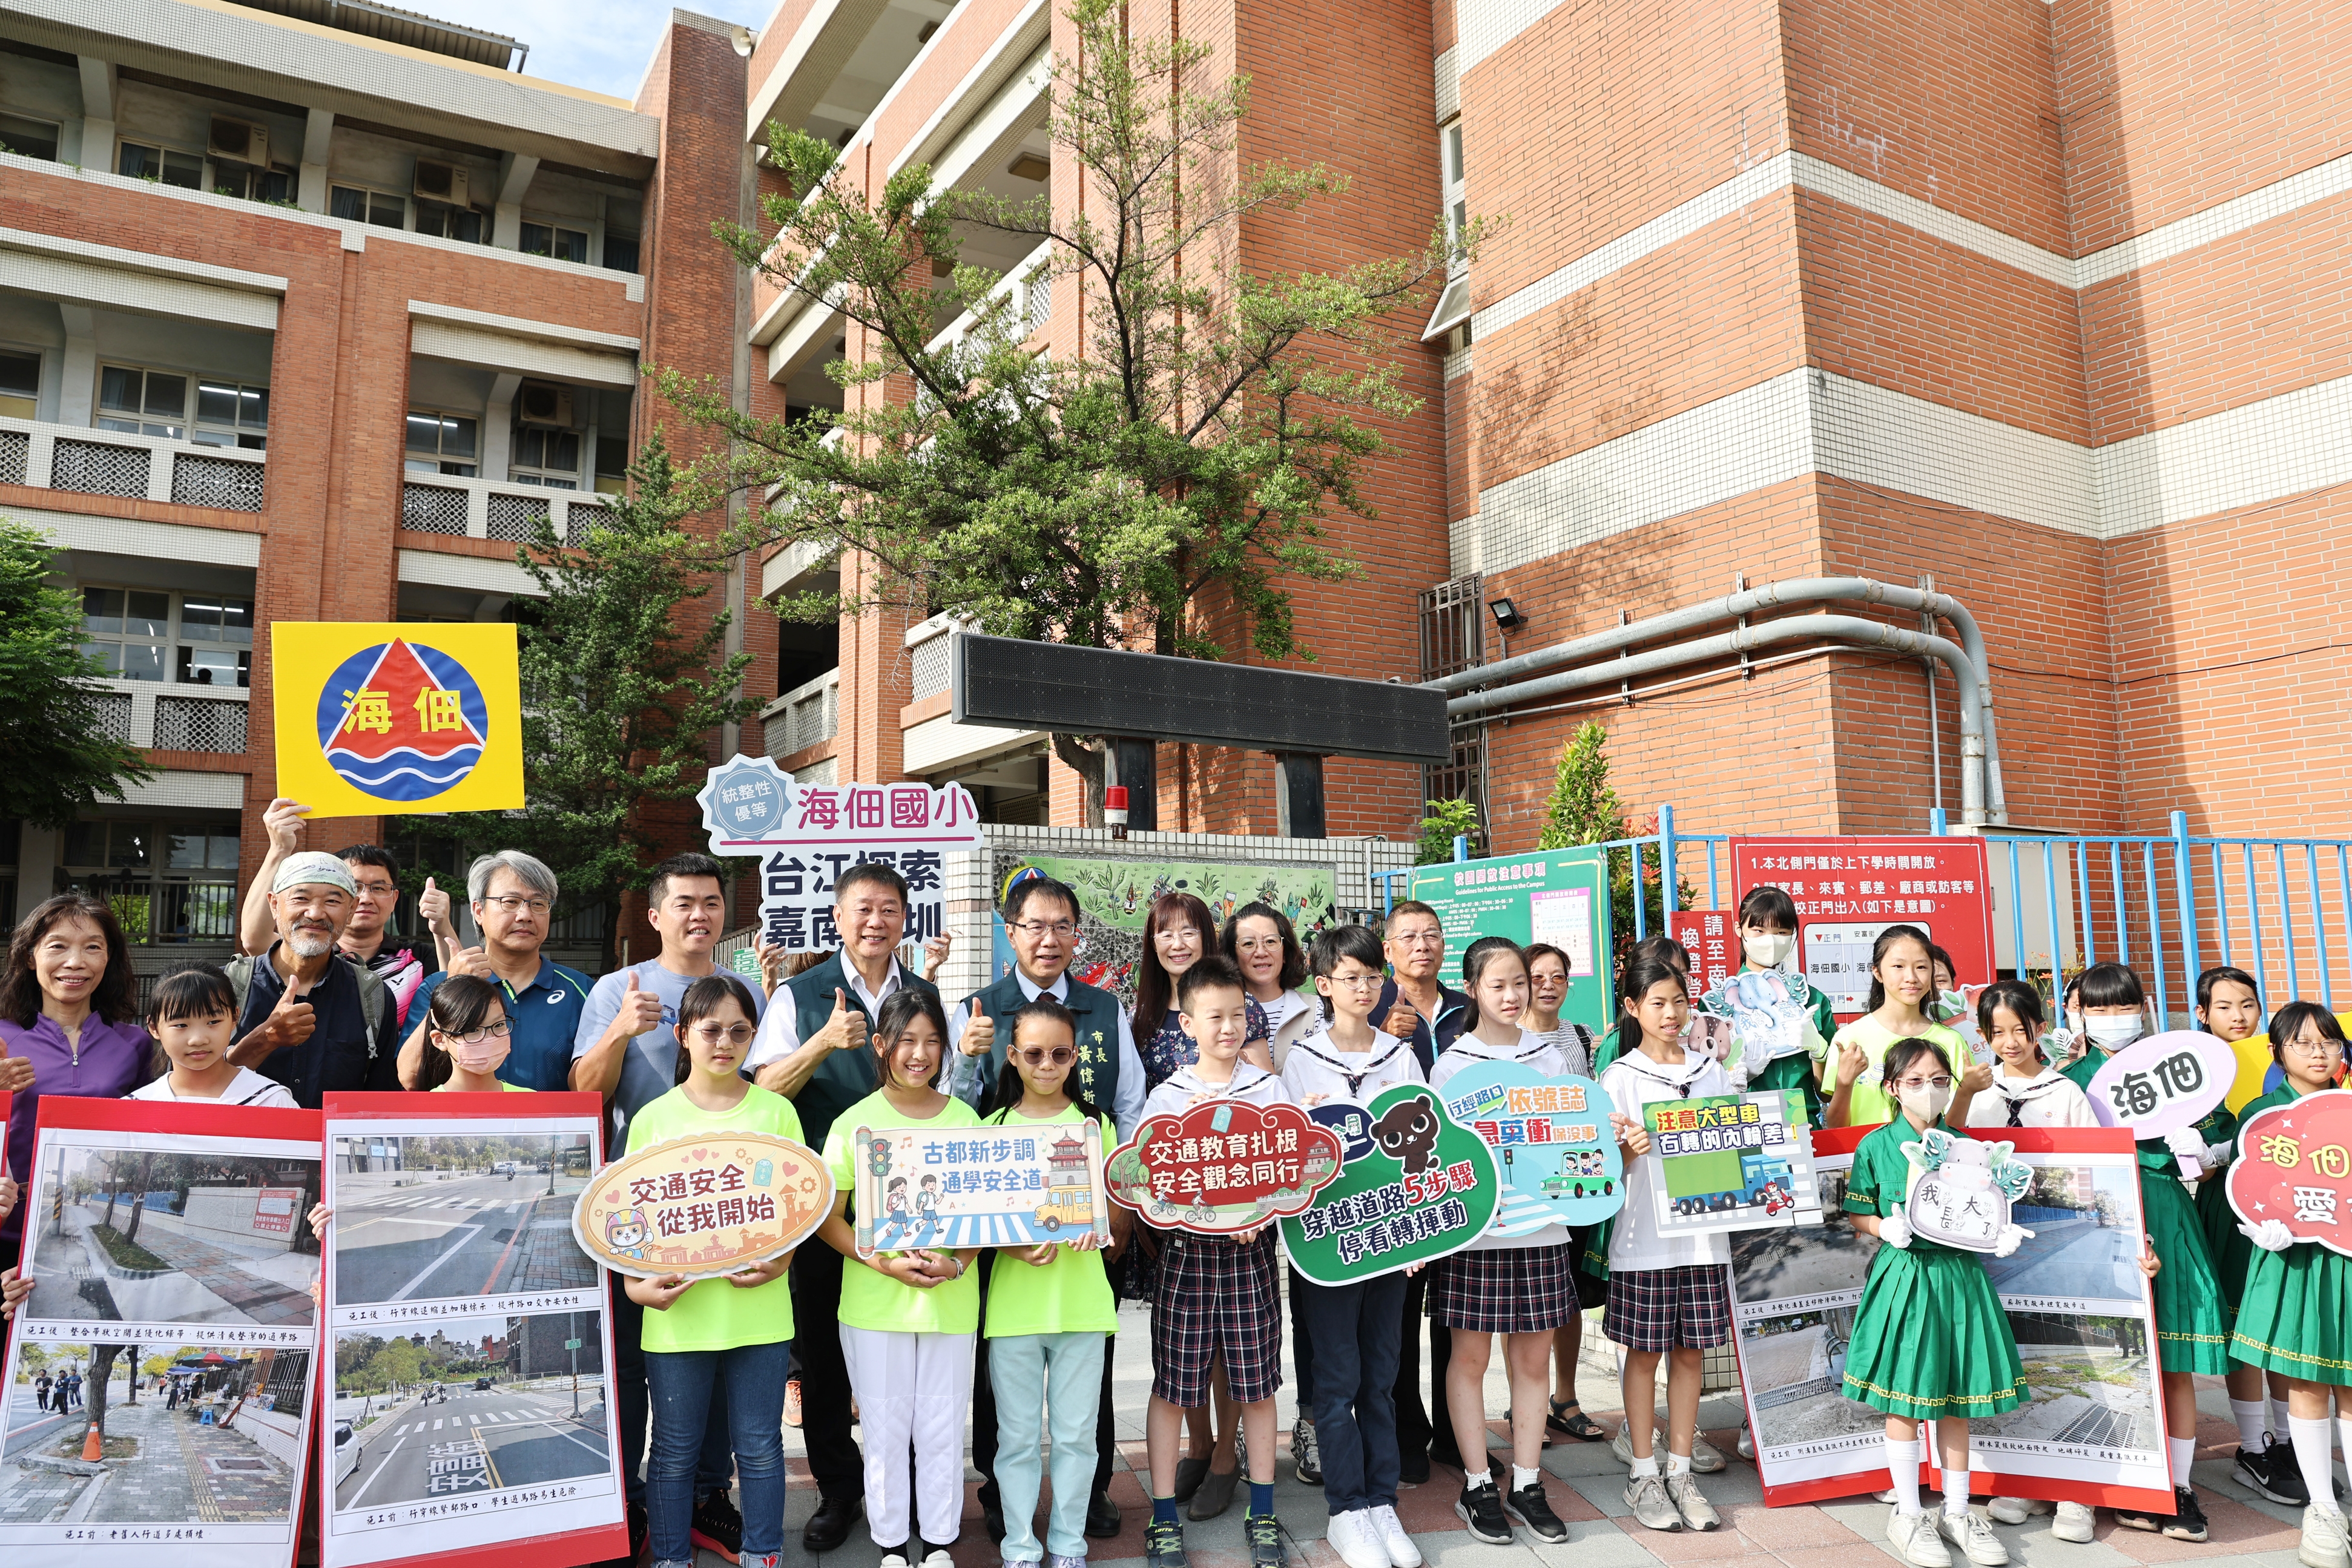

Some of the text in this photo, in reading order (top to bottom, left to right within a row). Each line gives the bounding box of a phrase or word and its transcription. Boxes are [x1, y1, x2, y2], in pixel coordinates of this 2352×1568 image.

[340, 687, 463, 734] 海佃
[721, 780, 772, 803] 統整性
[734, 800, 768, 822] 優等
[798, 786, 974, 830] 海佃國小
[1454, 862, 1546, 886] 校園開放注意事項
[765, 902, 941, 949] 嘉南圳
[1823, 934, 1841, 942] 正門
[1810, 963, 1850, 973] 海佃國小
[1092, 1030, 1108, 1062] 市長
[1507, 1086, 1587, 1113] 依號誌
[2111, 1052, 2204, 1118] 海佃
[1656, 1104, 1759, 1132] 注意大型車
[922, 1138, 1035, 1164] 古都新步調
[1149, 1128, 1298, 1167] 交通教育扎根
[2261, 1135, 2350, 1178] 海佃
[629, 1163, 745, 1206] 交通安全
[941, 1168, 1042, 1194] 通學安全道
[1152, 1158, 1299, 1196] 安全觀念同行
[1300, 1159, 1478, 1242] 穿越道路5步驟
[1921, 1182, 1939, 1206] 我
[1963, 1196, 1982, 1216] 大
[2293, 1186, 2352, 1225] 愛
[656, 1193, 775, 1237] 從我開始
[1940, 1207, 1952, 1228] 長
[1337, 1198, 1469, 1265] 停看轉揮動
